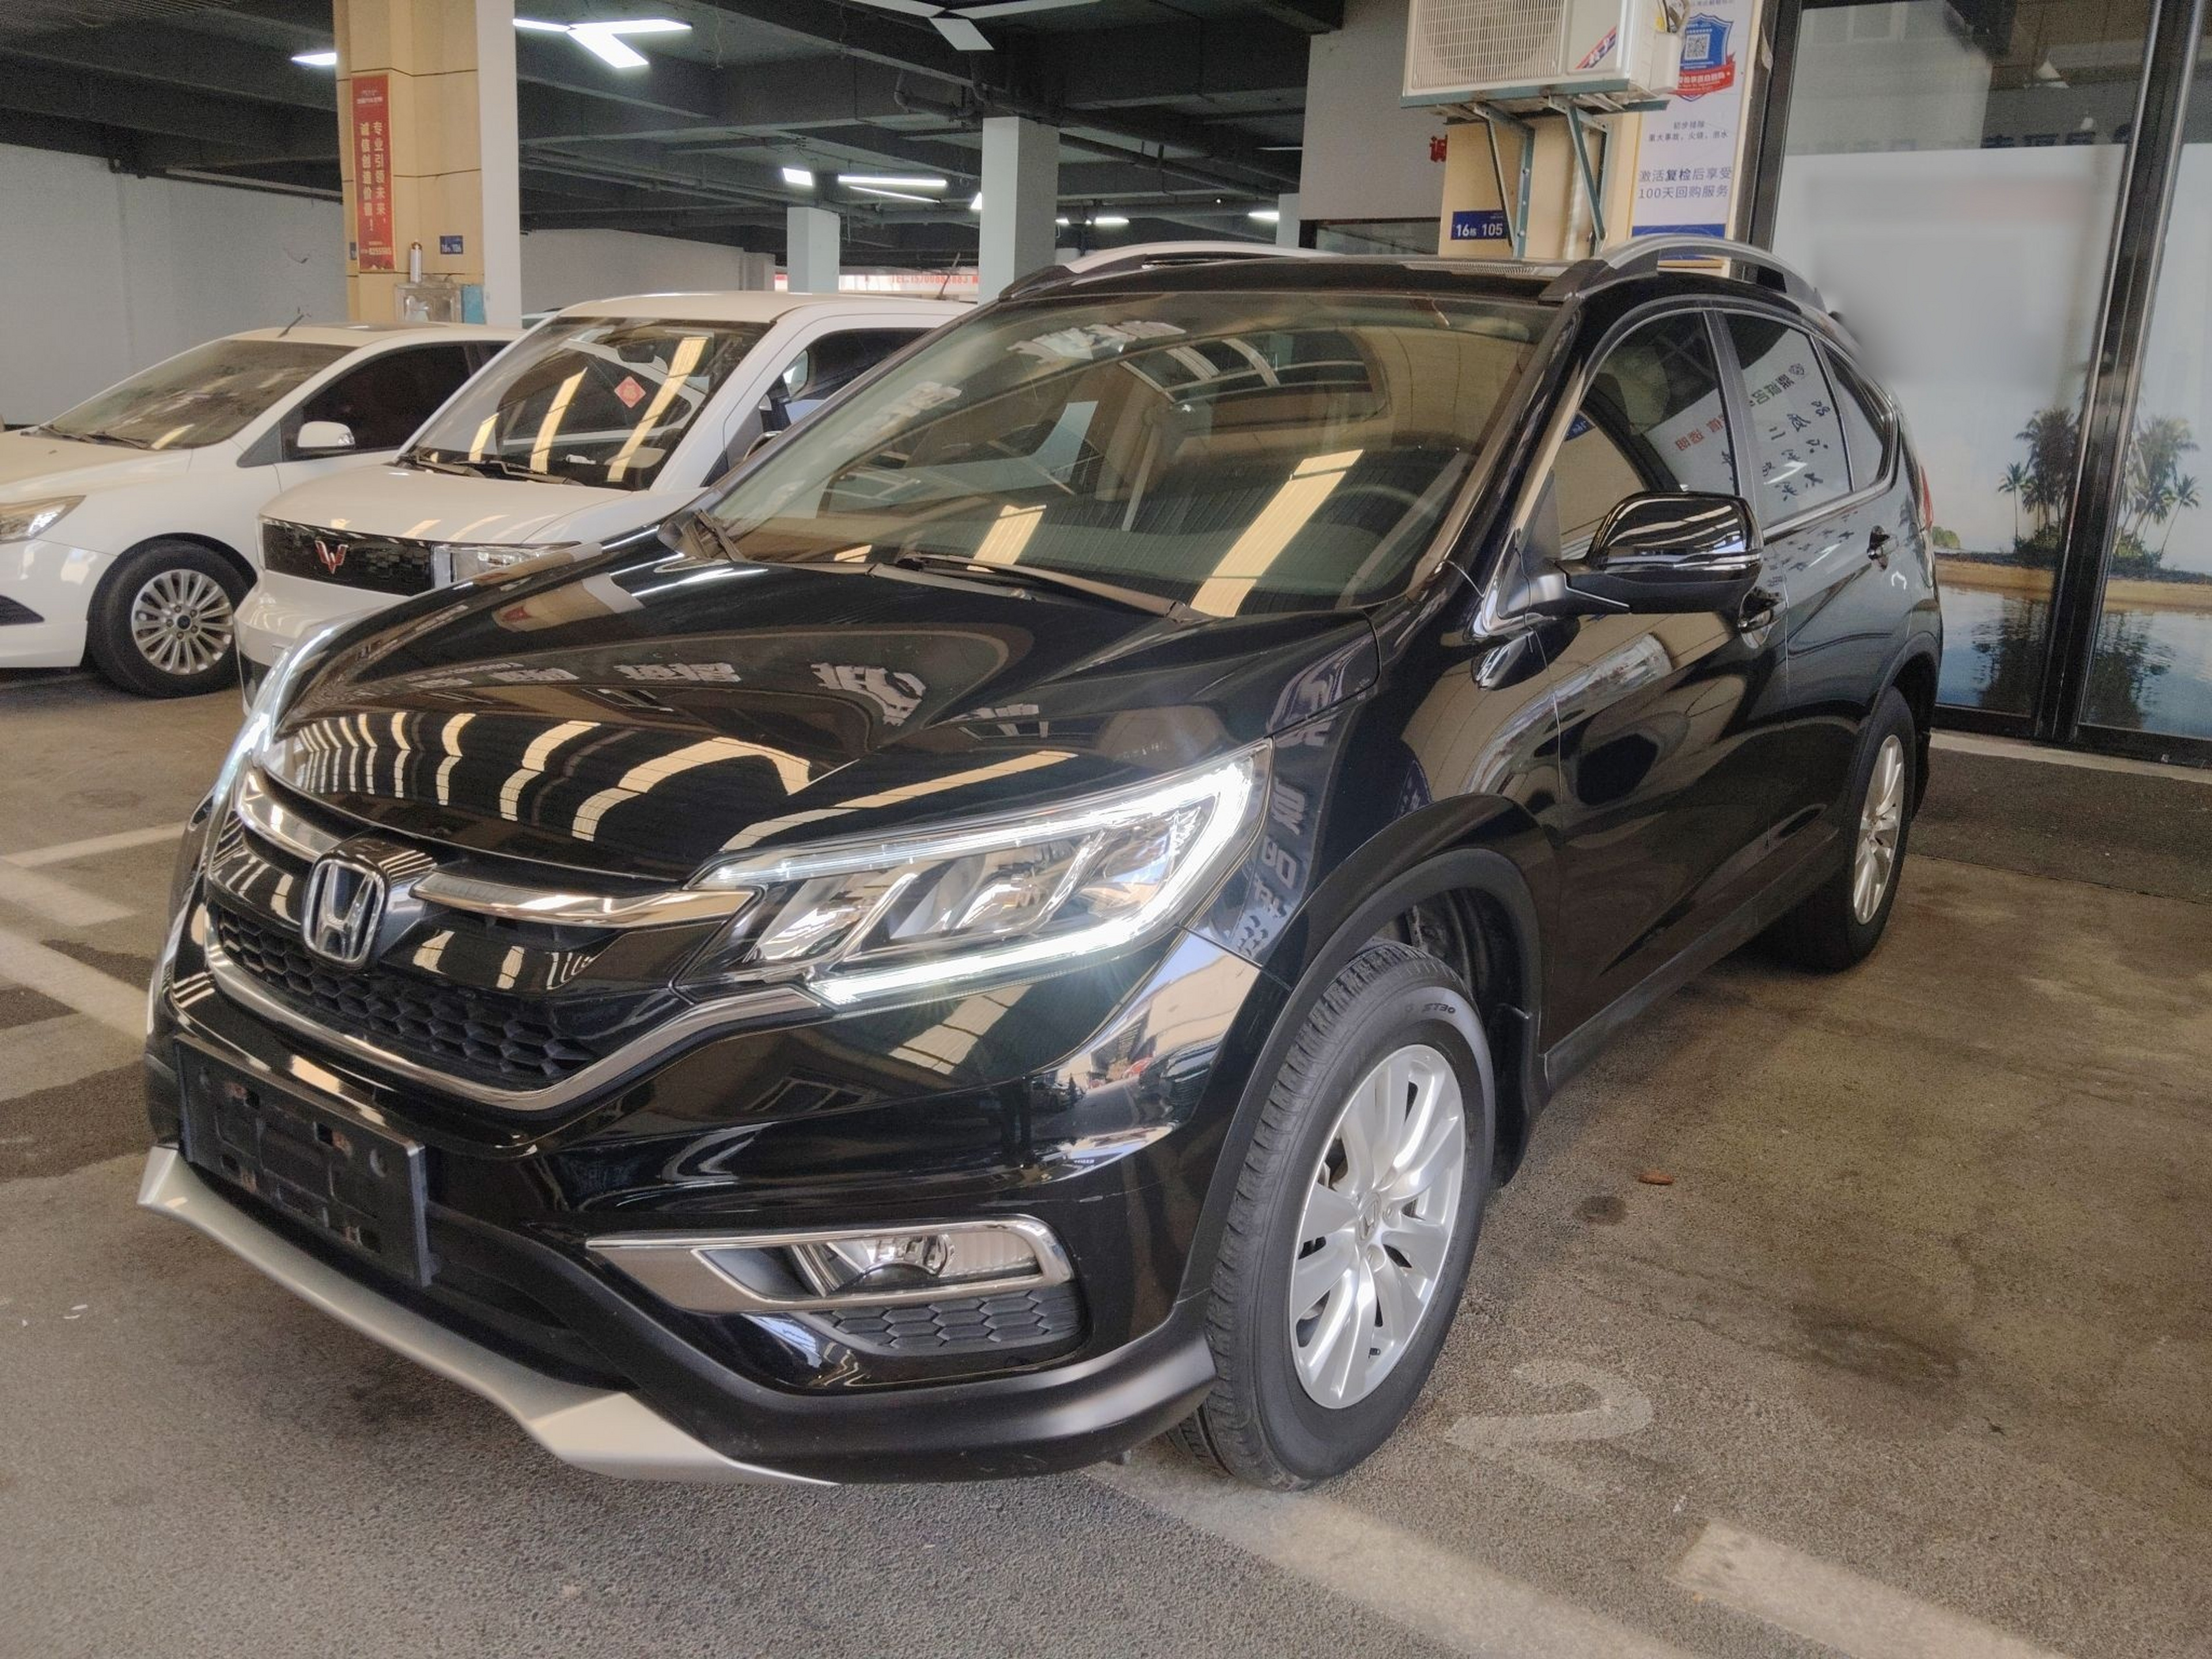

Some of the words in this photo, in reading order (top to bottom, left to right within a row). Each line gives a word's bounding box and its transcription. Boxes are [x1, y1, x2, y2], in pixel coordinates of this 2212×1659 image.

[1640, 167, 1732, 181] 激活复检后享受
[1638, 185, 1728, 199] 100天回购服务
[1482, 222, 1503, 236] 105
